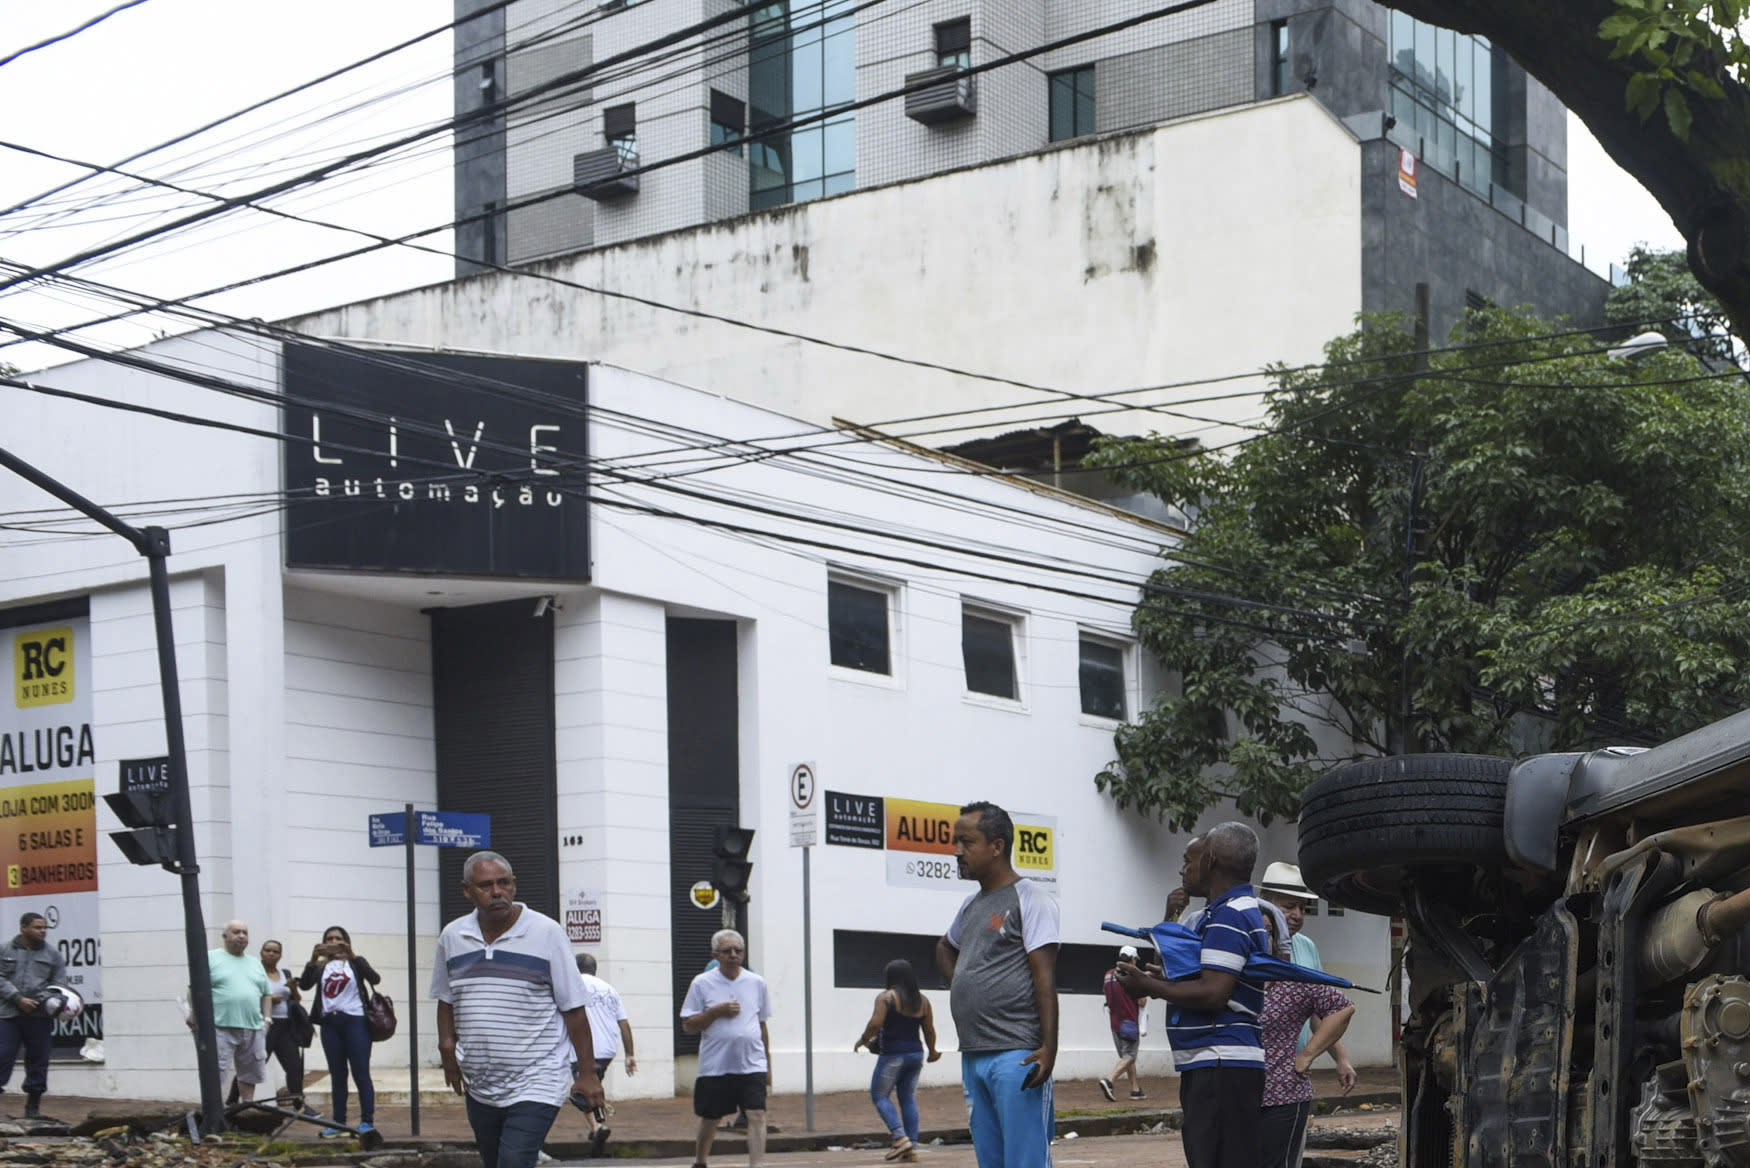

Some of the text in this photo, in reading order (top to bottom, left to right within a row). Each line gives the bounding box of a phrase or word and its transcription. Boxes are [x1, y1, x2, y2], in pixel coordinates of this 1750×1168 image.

[313, 412, 561, 476] LIVE
[314, 477, 563, 508] automação
[22, 636, 66, 681] RC
[21, 681, 68, 700] NUNES
[0, 723, 95, 775] ALUGA
[127, 763, 168, 784] LIVE
[798, 772, 808, 801] E
[30, 794, 60, 816] COM
[833, 797, 876, 817] LIVE
[18, 828, 84, 852] 6 SALAS E
[897, 815, 957, 846] ALUG
[1018, 830, 1048, 854] RC
[21, 862, 94, 886] BANHEIROS
[566, 910, 600, 925] ALUGA
